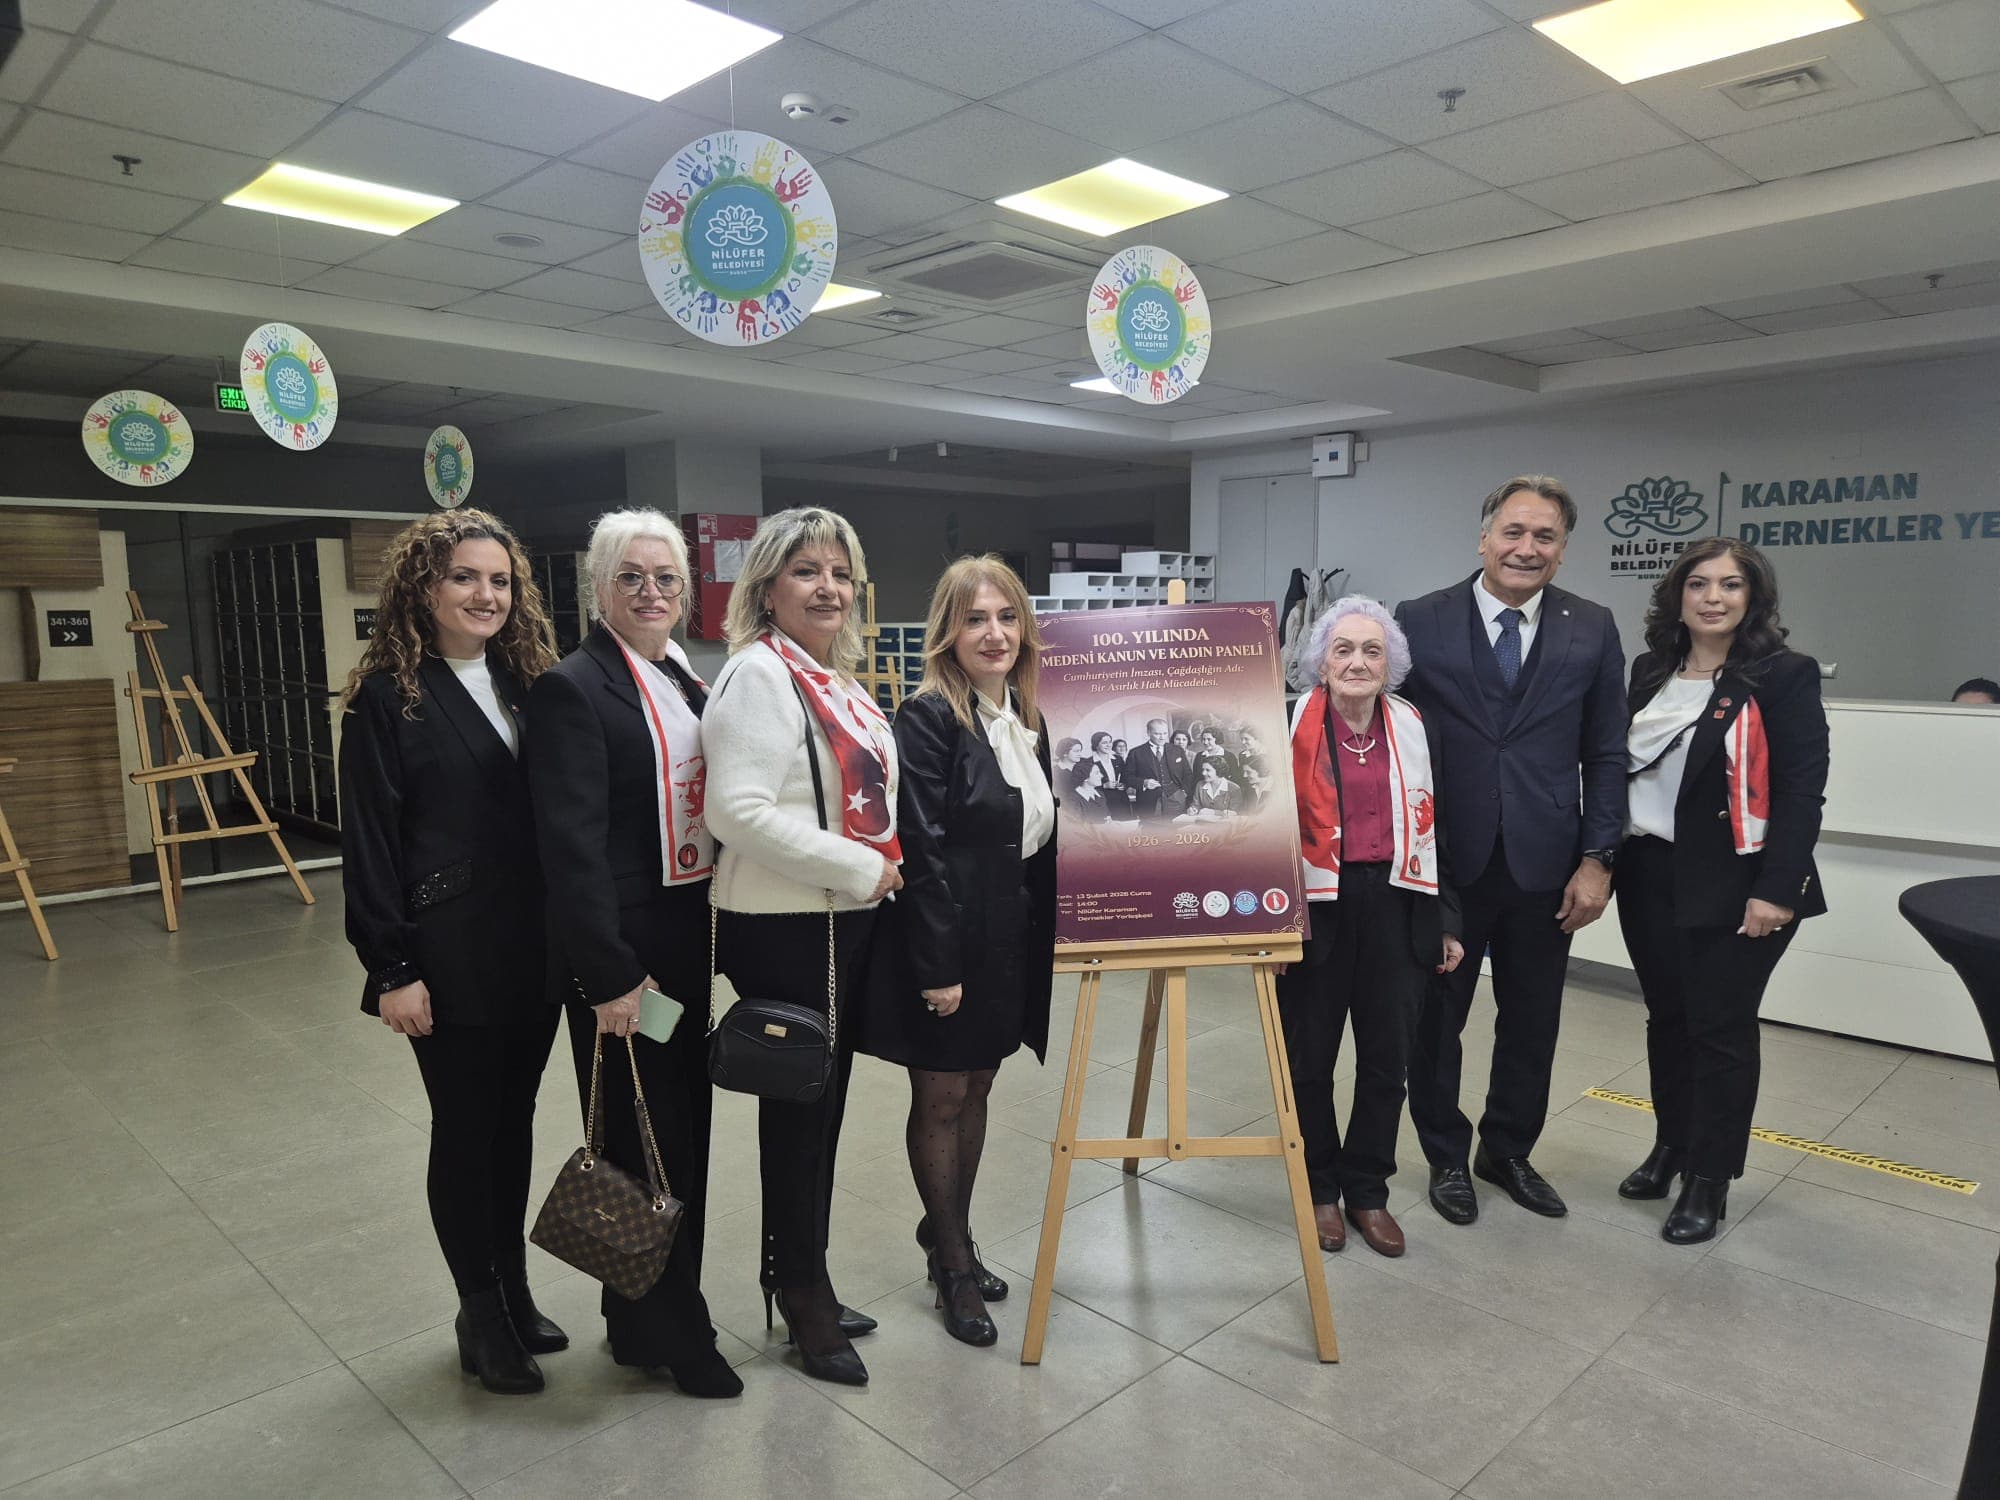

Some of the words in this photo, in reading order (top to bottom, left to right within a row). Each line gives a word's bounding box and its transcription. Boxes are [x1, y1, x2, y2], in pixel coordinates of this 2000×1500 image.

[711, 248, 765, 259] NİLÜFER
[712, 259, 764, 269] BELEDİYESİ
[220, 387, 246, 400] EXIT
[1741, 472, 1918, 508] KARAMAN
[1740, 514, 1943, 546] DERNEKLER
[1611, 539, 1696, 556] NİLÜFE
[1610, 557, 1674, 571] BELEDİY
[50, 617, 89, 626] 341-360
[1092, 632, 1129, 647] 100.
[1131, 628, 1210, 644] YILINDA
[1041, 650, 1095, 668] MEDENİ
[1097, 649, 1146, 664] KANUN
[1148, 648, 1167, 660] VE
[1169, 646, 1213, 659] KADIN
[1215, 642, 1264, 657] PANELİ
[1063, 669, 1128, 682] Cumhuriyetin
[1091, 683, 1105, 692] Bir
[1107, 681, 1139, 692] Asırlık
[1140, 679, 1161, 689] Hak
[1163, 677, 1219, 688] Mücadelesi.
[1128, 835, 1159, 848] 1926
[1175, 832, 1210, 845] 2026
[1878, 1163, 1965, 1189] KORUYUN
